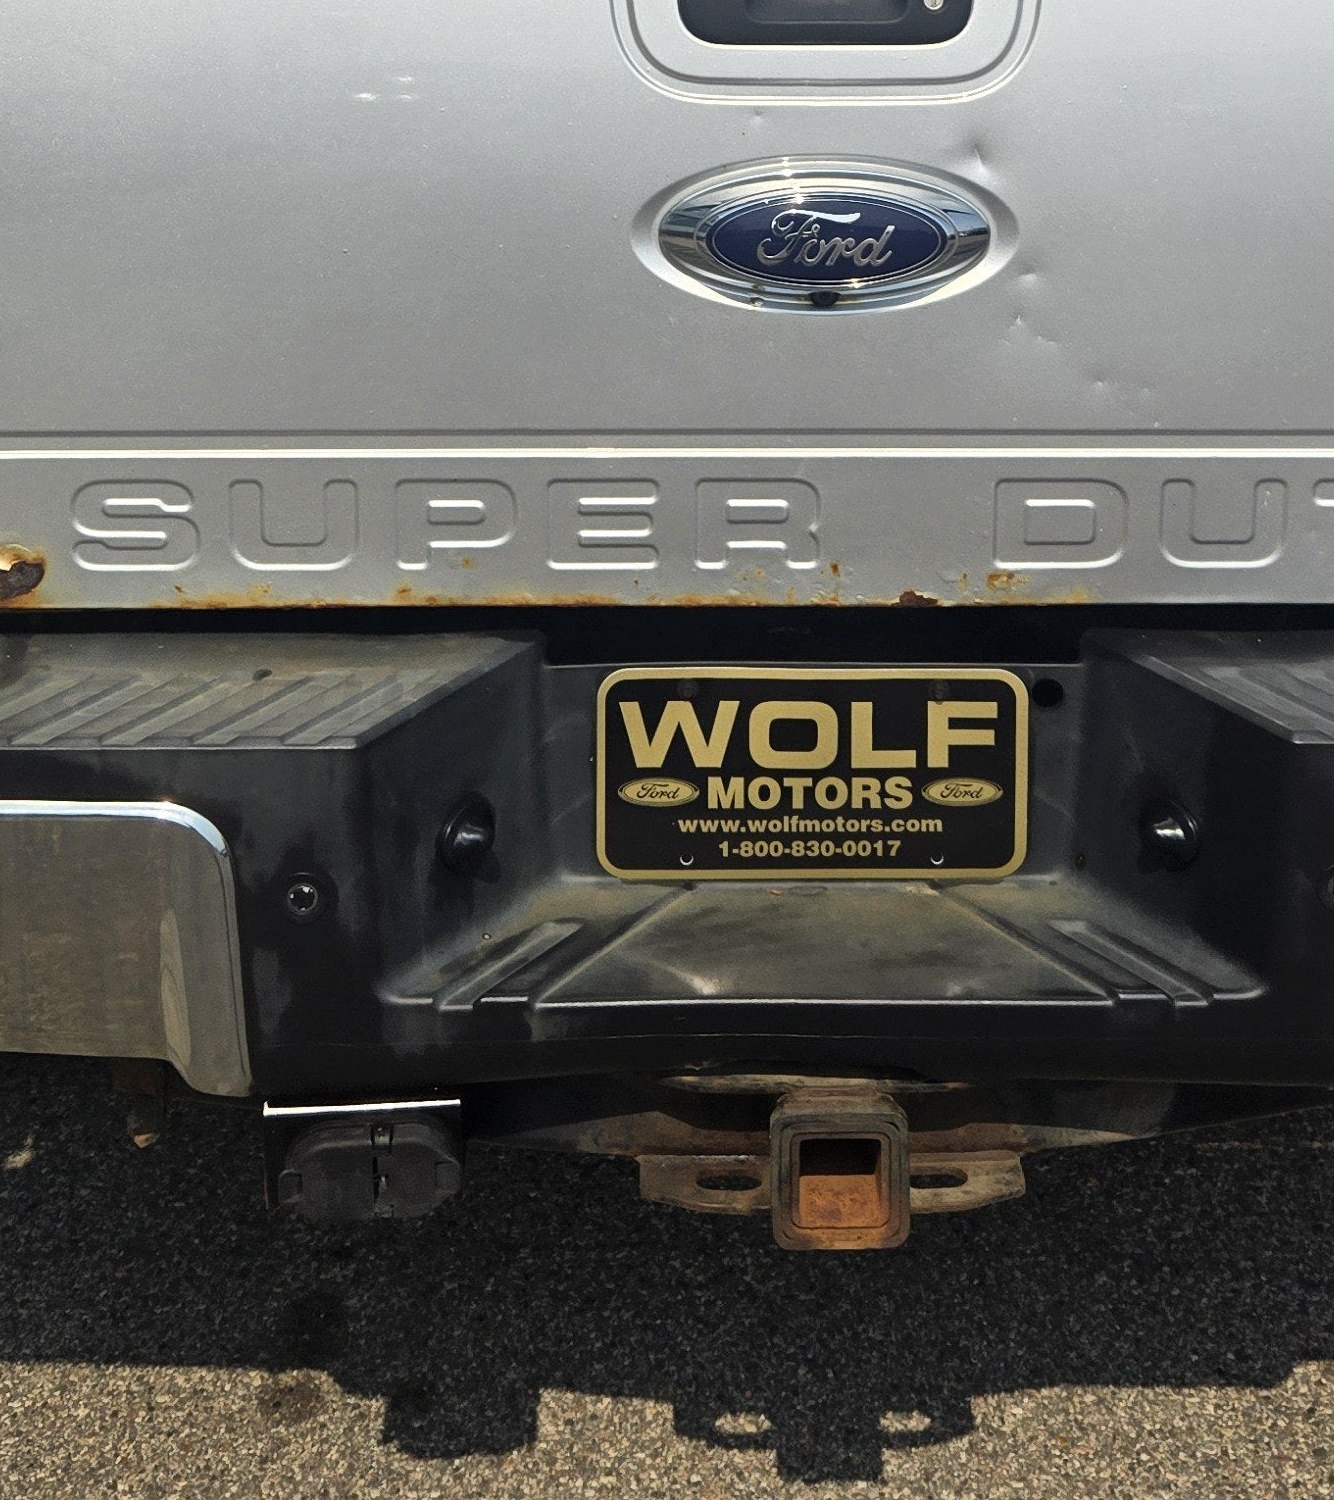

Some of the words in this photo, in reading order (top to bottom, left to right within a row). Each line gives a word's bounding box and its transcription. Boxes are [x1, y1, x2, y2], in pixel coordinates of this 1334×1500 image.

[756, 209, 898, 268] Ford
[70, 478, 823, 572] SUPER
[619, 700, 999, 769] WOLF
[636, 782, 680, 800] Ford
[706, 776, 914, 810] MOTORS
[939, 782, 984, 800] Ford
[677, 815, 943, 834] www.wolfmotors.com
[718, 840, 901, 858] 1-800-830-0017
